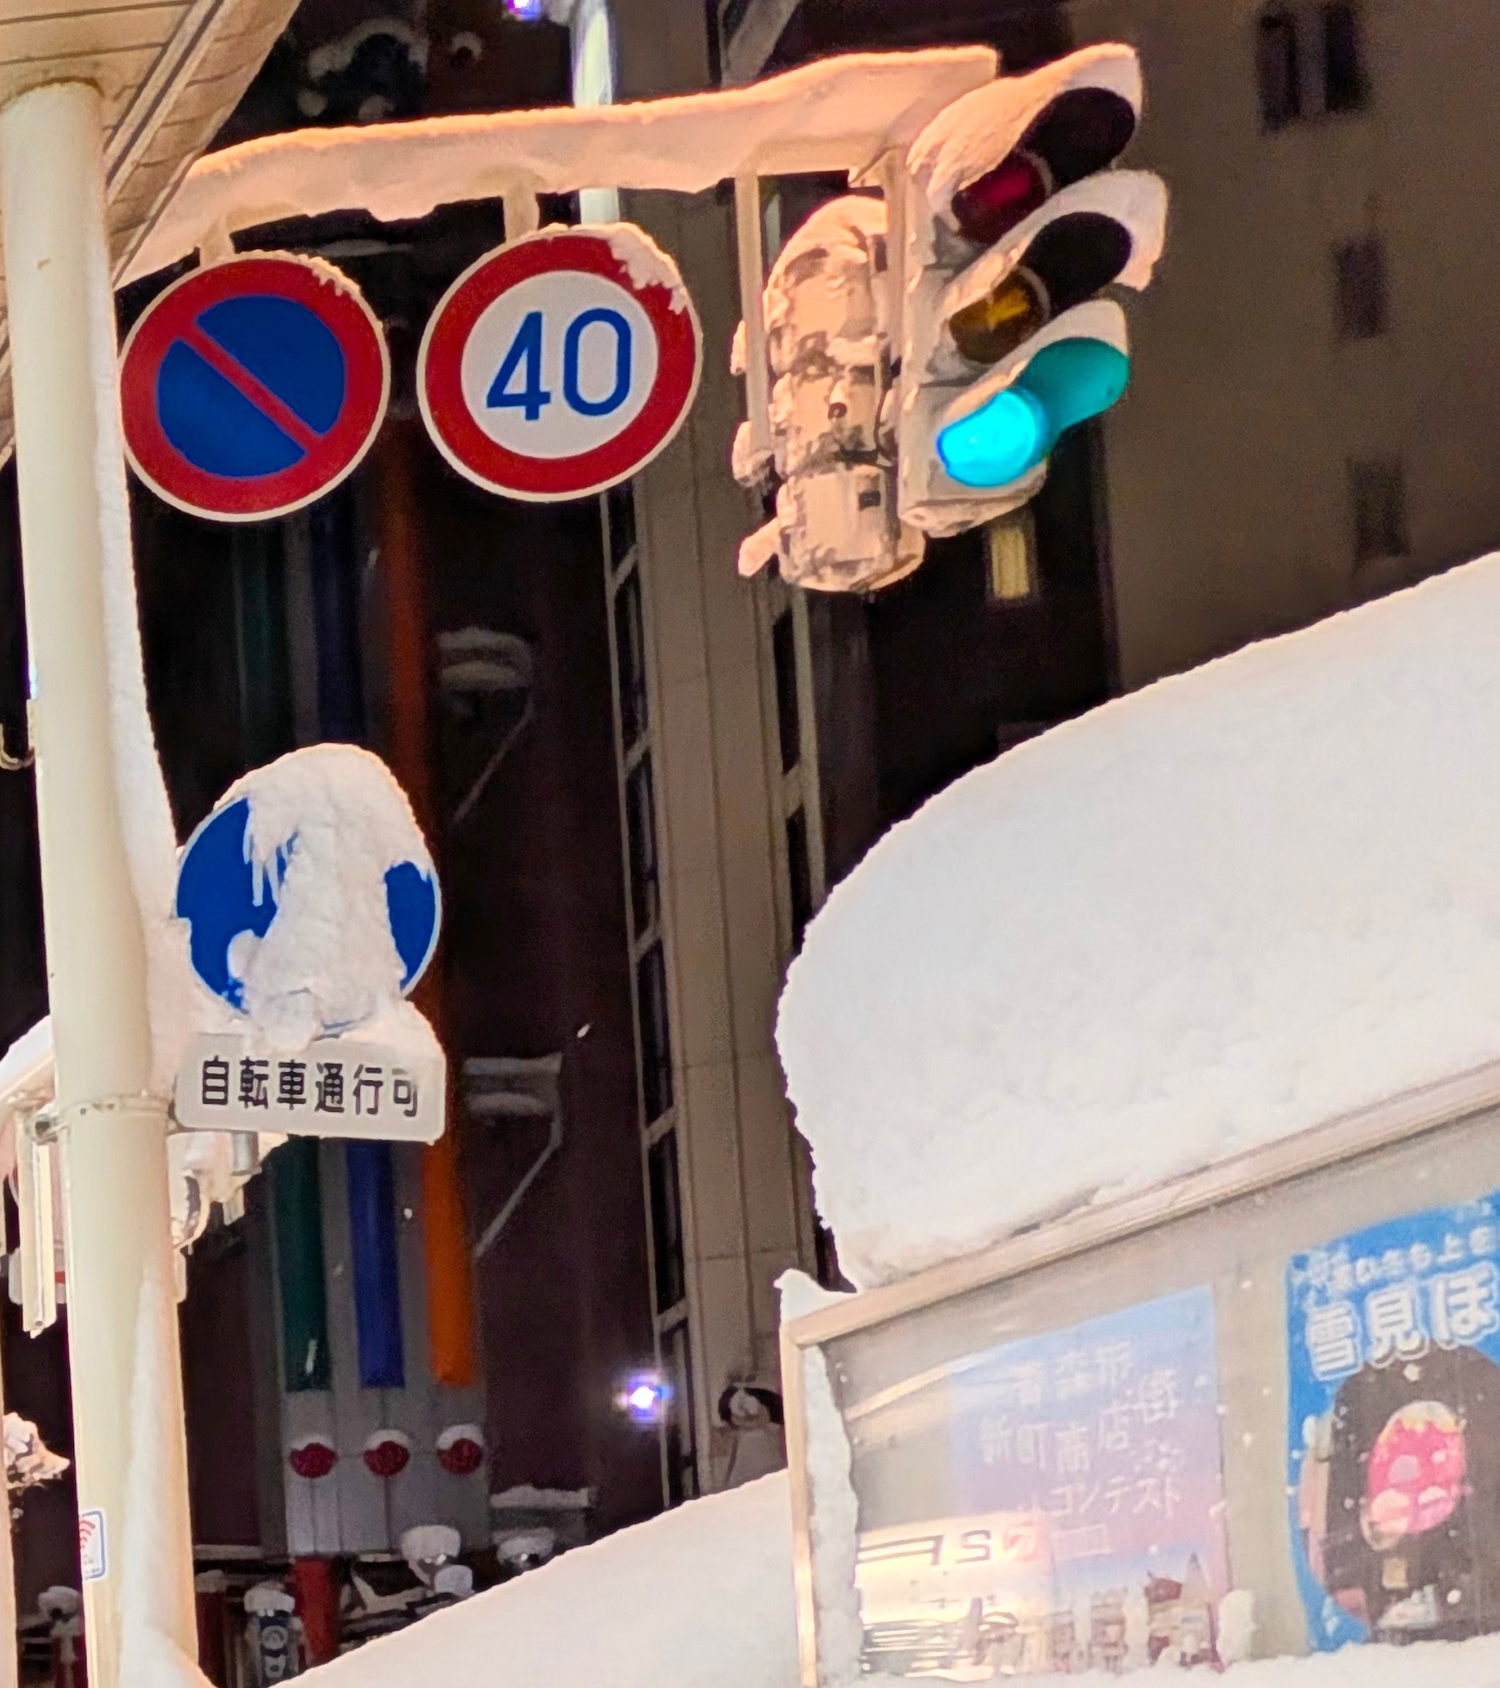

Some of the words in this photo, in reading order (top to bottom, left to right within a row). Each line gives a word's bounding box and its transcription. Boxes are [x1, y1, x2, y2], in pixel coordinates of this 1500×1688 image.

[486, 308, 631, 420] 40
[202, 1055, 418, 1117] 自転車通行可
